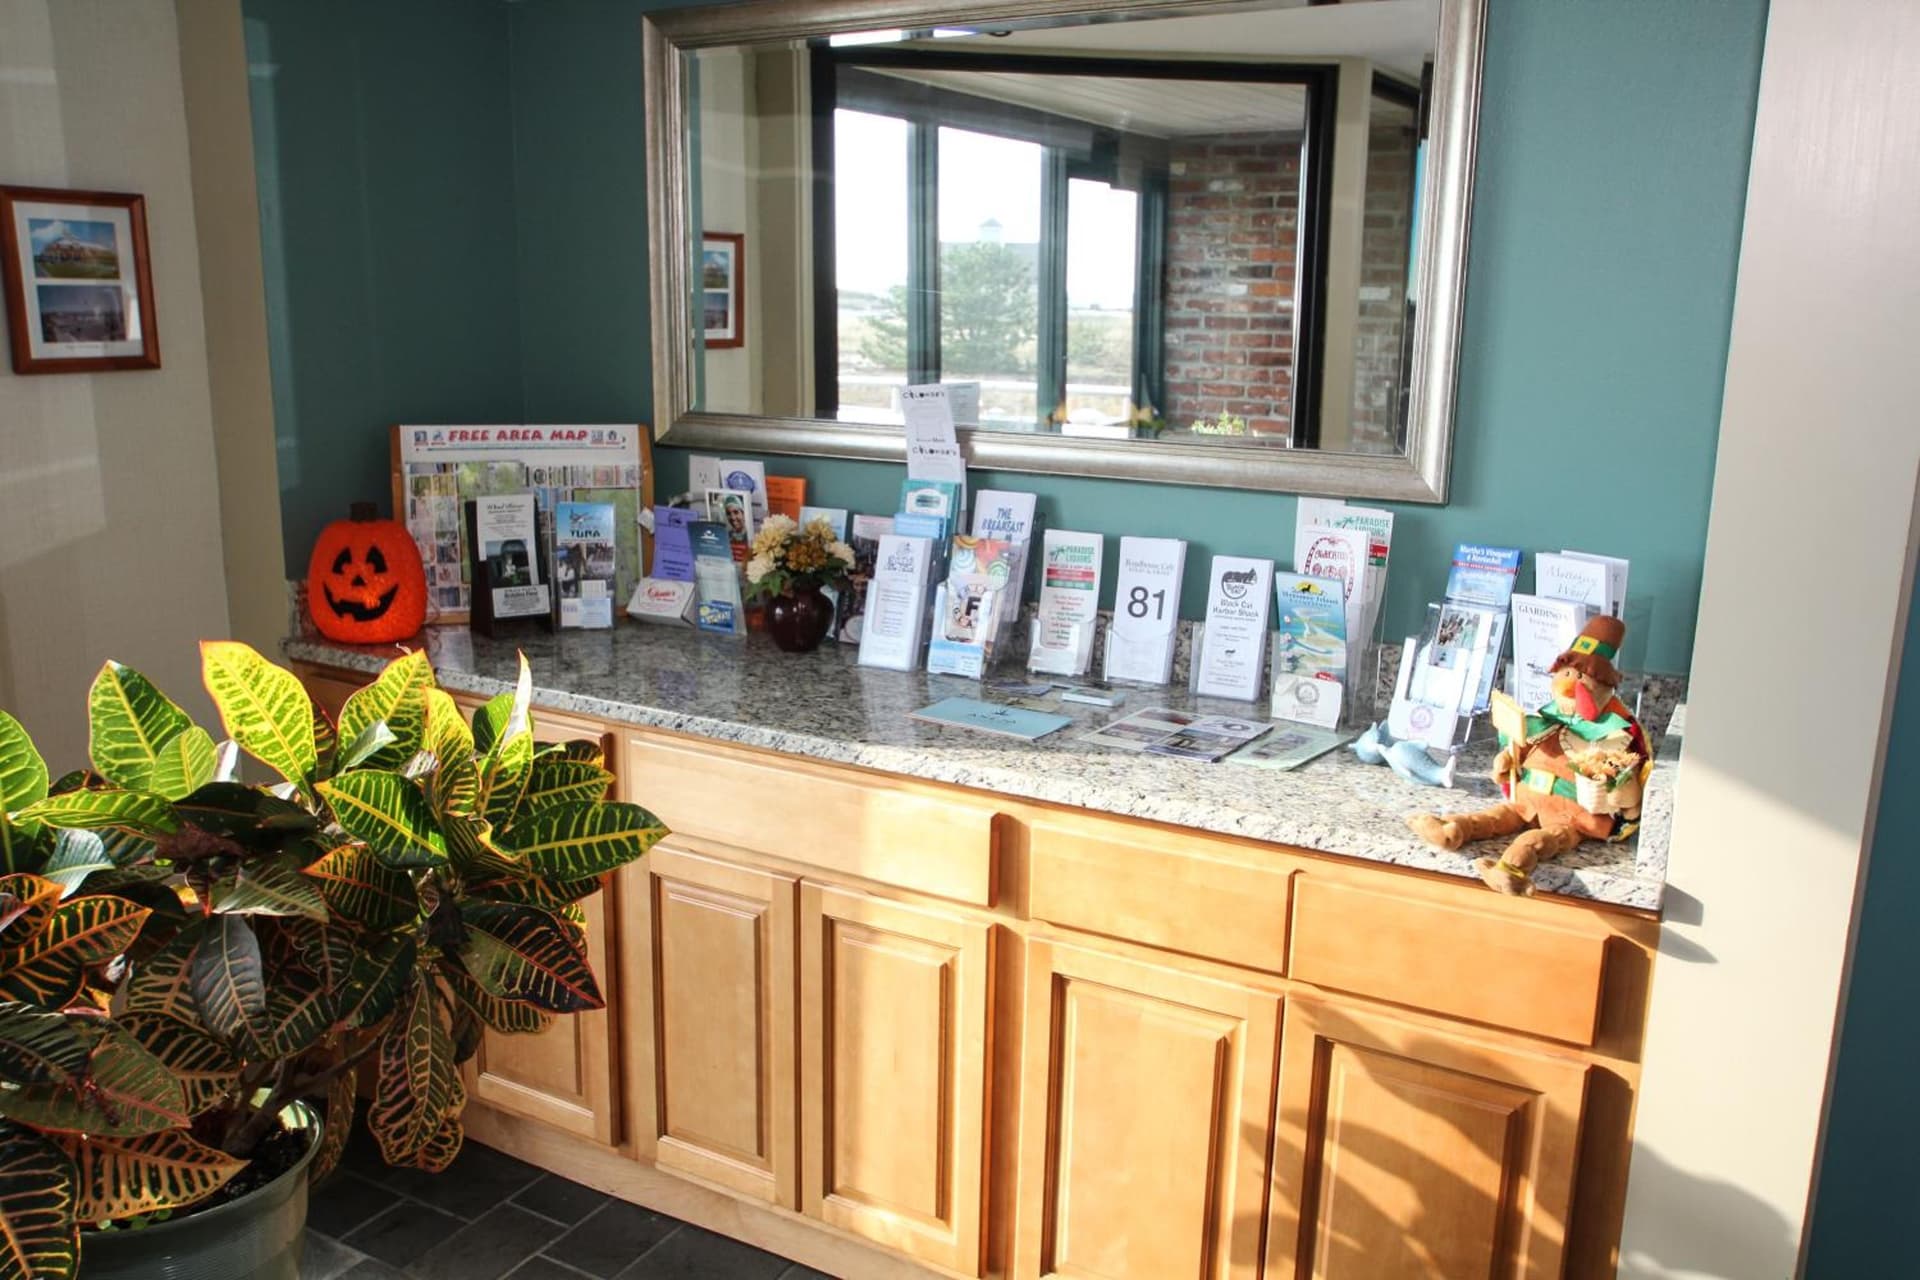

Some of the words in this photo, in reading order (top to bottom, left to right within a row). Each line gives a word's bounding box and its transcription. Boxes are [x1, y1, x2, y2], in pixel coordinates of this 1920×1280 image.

[448, 429, 490, 441] FREE
[496, 429, 543, 441] AREA
[550, 429, 588, 441] MAP
[997, 507, 1013, 520] THE
[981, 517, 1025, 534] BREAKFAST
[1127, 586, 1166, 621] 81
[1240, 599, 1253, 610] Cat
